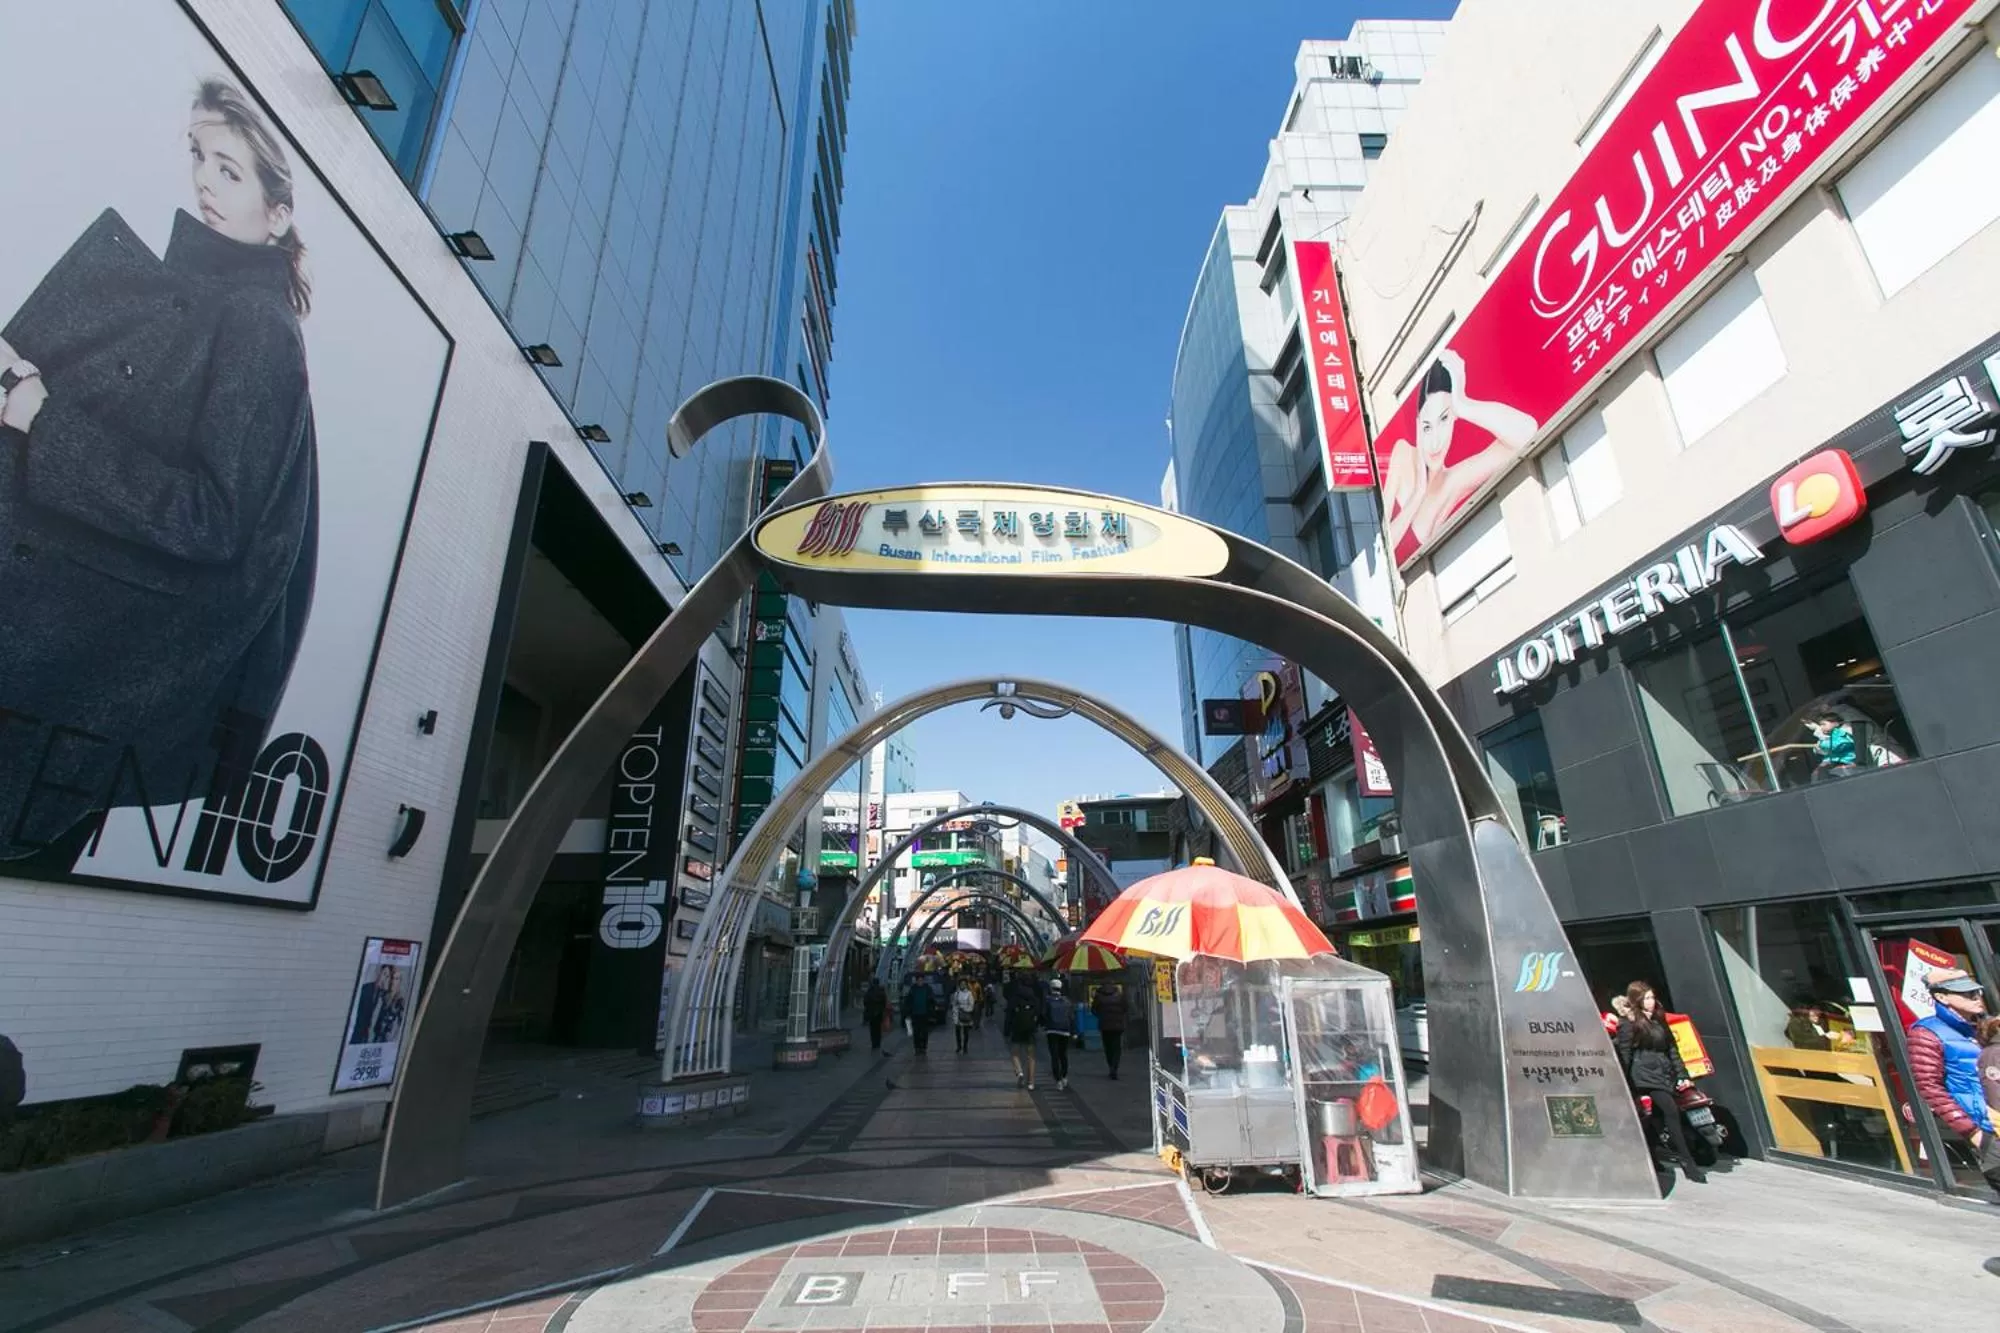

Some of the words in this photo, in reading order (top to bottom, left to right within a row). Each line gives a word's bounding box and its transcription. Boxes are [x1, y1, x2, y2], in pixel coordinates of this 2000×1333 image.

[1566, 283, 1627, 352] 프랑스
[1632, 162, 1733, 278] 에스테틱
[1894, 350, 2000, 476] 롯
[881, 508, 1130, 541] 부산국제영화제
[879, 544, 922, 561] Busan
[932, 548, 1022, 565] International
[1031, 550, 1062, 564] Film
[1071, 542, 1132, 561] Festival
[1493, 523, 1766, 695] LOTTERIA
[1528, 1021, 1576, 1035] BUSAN
[1522, 1065, 1605, 1083] 부산국제영화제
